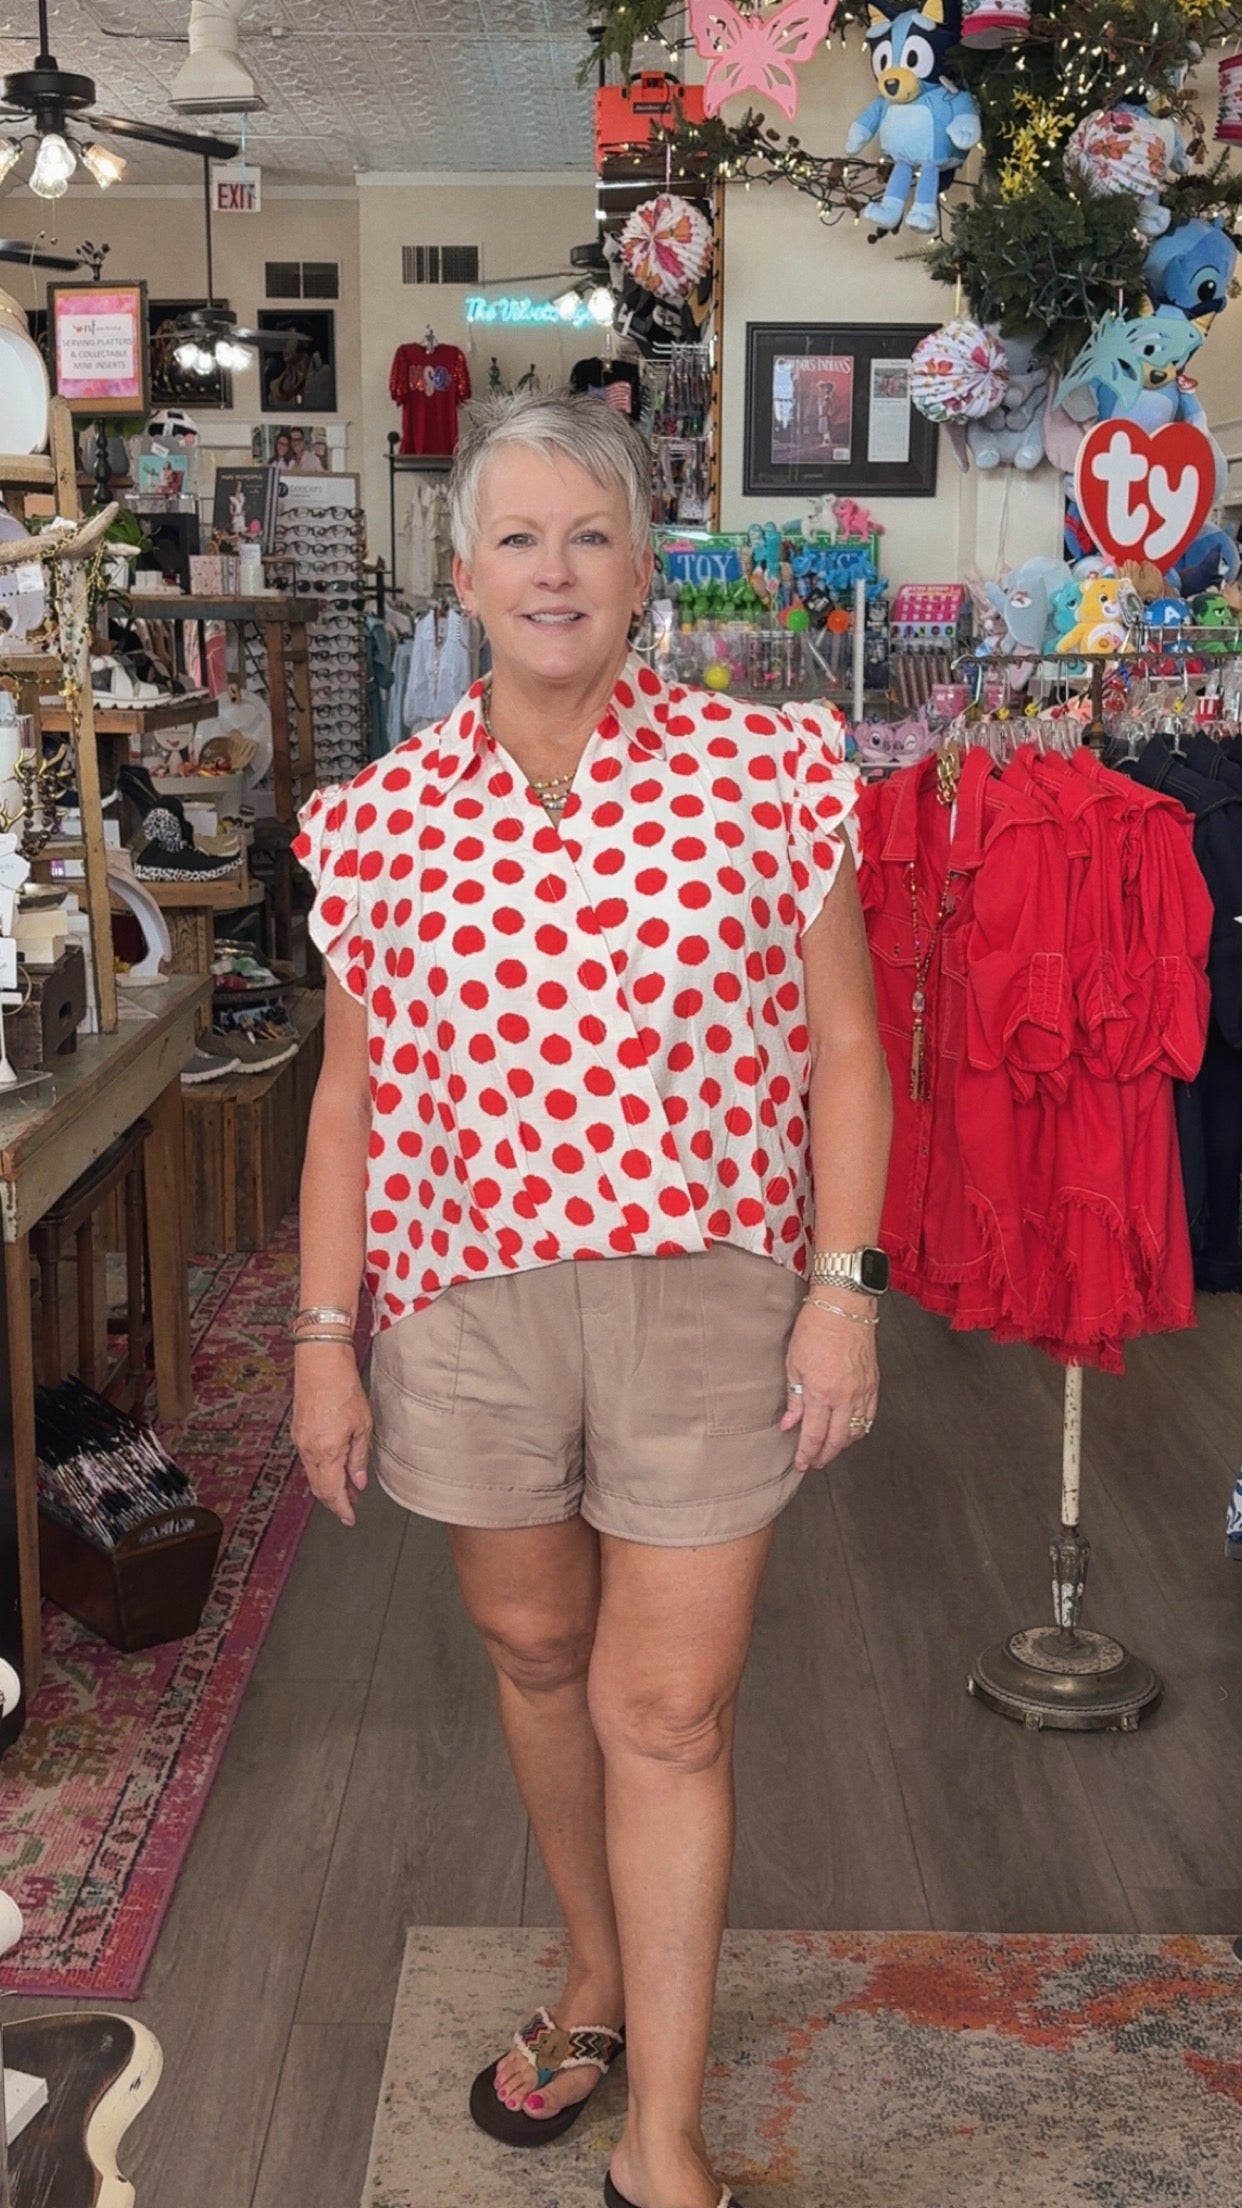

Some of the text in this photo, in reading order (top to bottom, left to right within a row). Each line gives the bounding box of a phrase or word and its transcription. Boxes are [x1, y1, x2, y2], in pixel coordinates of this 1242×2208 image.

[218, 184, 255, 209] EXIT
[466, 297, 496, 322] The
[62, 338, 133, 347] SERVING PLATTERS
[71, 350, 127, 358] & COLLECTABLE
[96, 361, 126, 369] INSERTS
[1091, 430, 1199, 561] ty
[677, 555, 733, 584] TOY
[892, 625, 954, 638] BINGO
